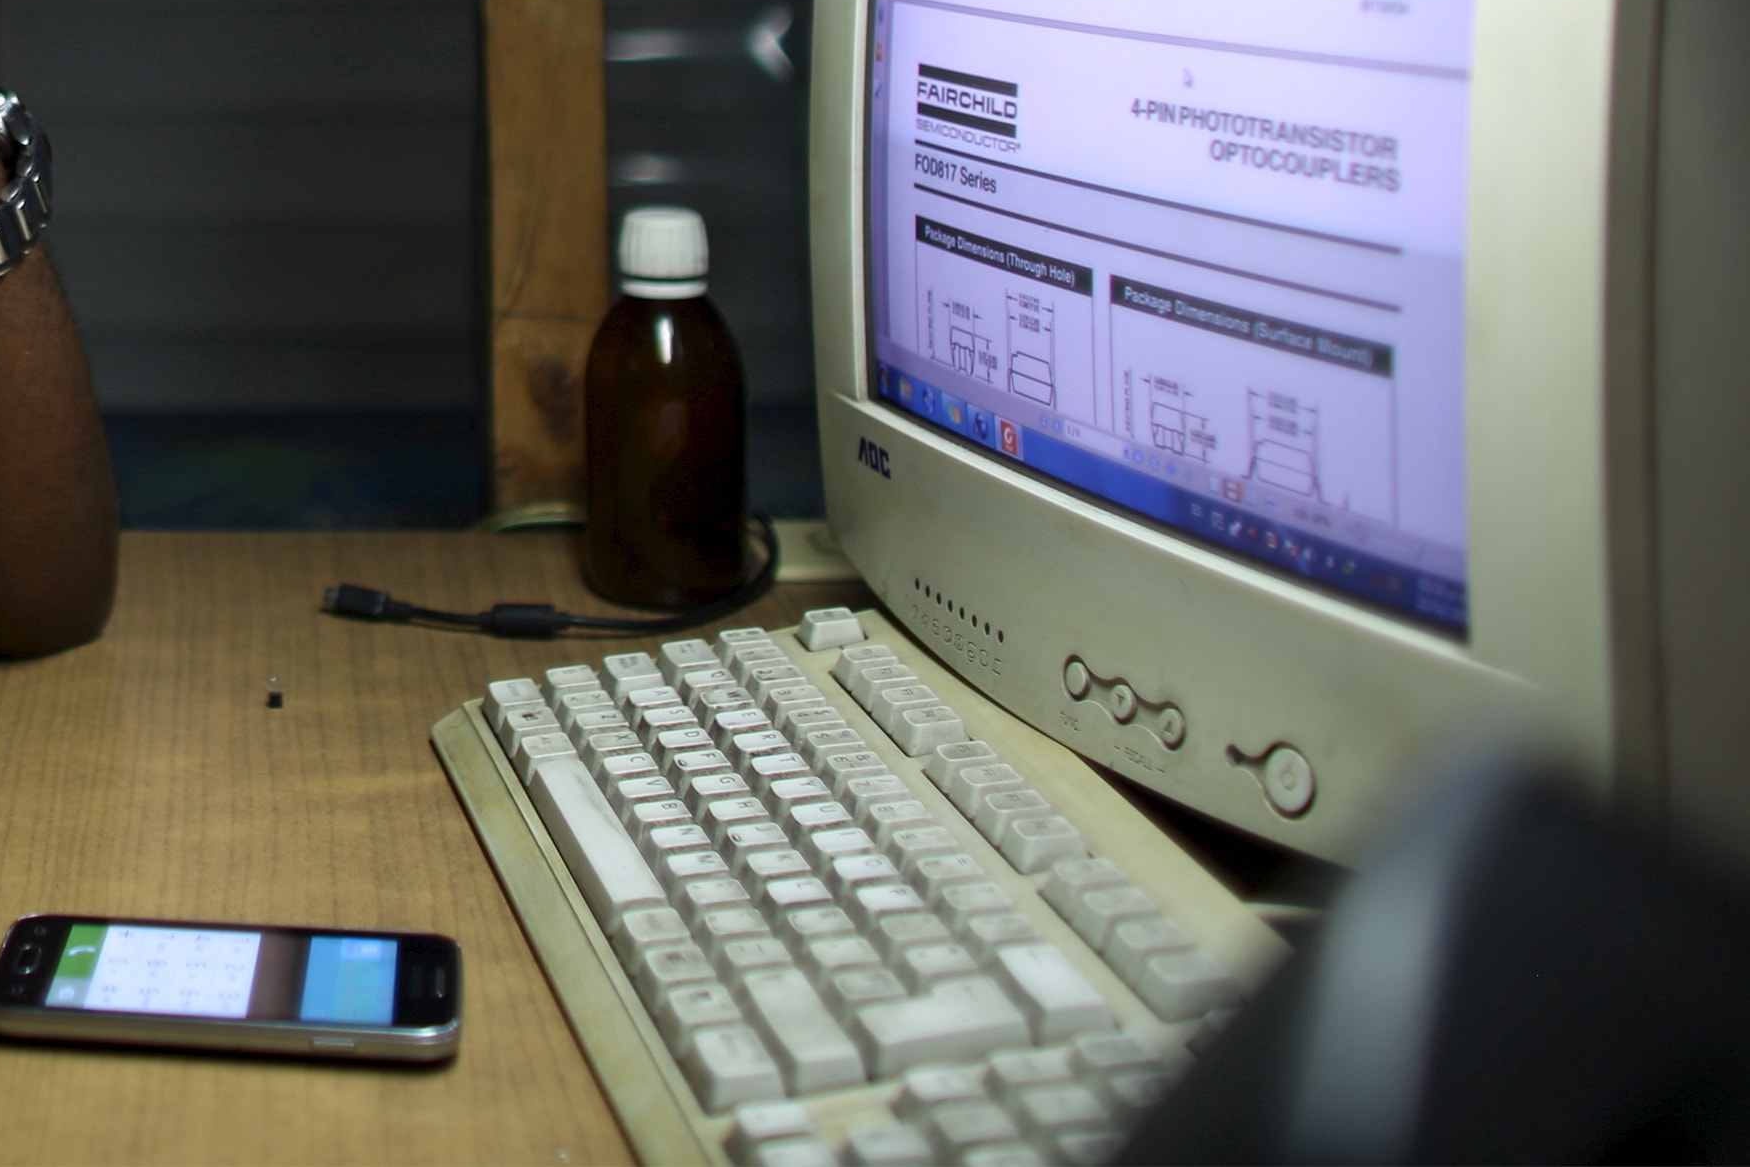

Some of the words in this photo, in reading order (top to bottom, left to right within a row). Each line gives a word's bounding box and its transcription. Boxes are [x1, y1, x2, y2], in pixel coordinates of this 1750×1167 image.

[917, 82, 1018, 119] FAIRCHILD
[1131, 98, 1176, 125] 4-PIN
[1179, 106, 1399, 160] PHOTOTRANSISTOR
[915, 153, 957, 181] FOD817
[960, 167, 997, 194] Series
[1209, 139, 1400, 192] OPTOCOUPLERS
[925, 224, 956, 249] Package
[957, 236, 1005, 264] Dimensions
[1006, 252, 1047, 279] (Through
[1049, 264, 1075, 287] Hole)
[1124, 286, 1172, 314] Package
[1175, 300, 1250, 333] Dimensions
[1252, 321, 1314, 350] (Surface
[1317, 337, 1373, 368] Mount)
[858, 436, 892, 480] AOC
